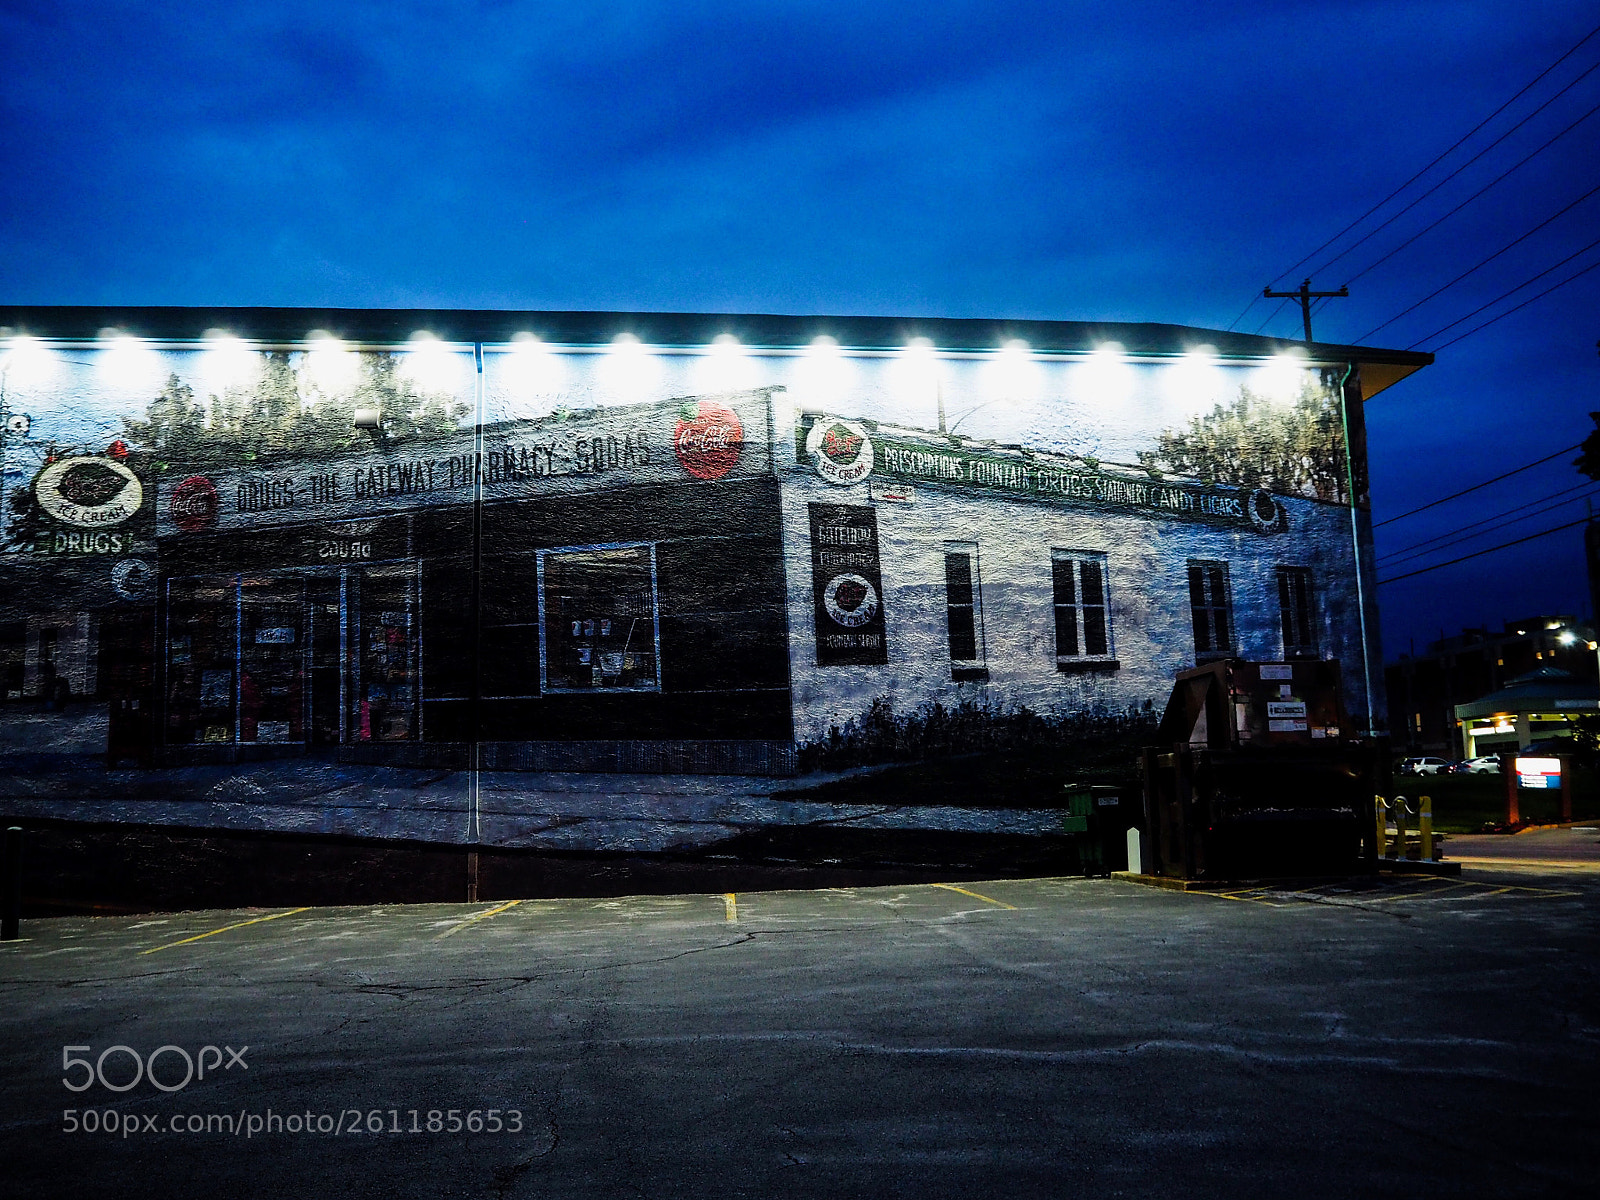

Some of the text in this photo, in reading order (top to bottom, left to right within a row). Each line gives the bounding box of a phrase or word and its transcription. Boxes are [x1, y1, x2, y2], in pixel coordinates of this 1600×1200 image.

[354, 460, 436, 499] GATEWAY
[839, 462, 866, 481] CREAM
[1037, 470, 1093, 499] DRUGS
[1095, 478, 1148, 505] STATIONERY
[1150, 486, 1195, 513] CANDY
[1199, 493, 1244, 518] CIGARS
[56, 504, 129, 523] ICE CREAM
[54, 531, 123, 555] DRUGS
